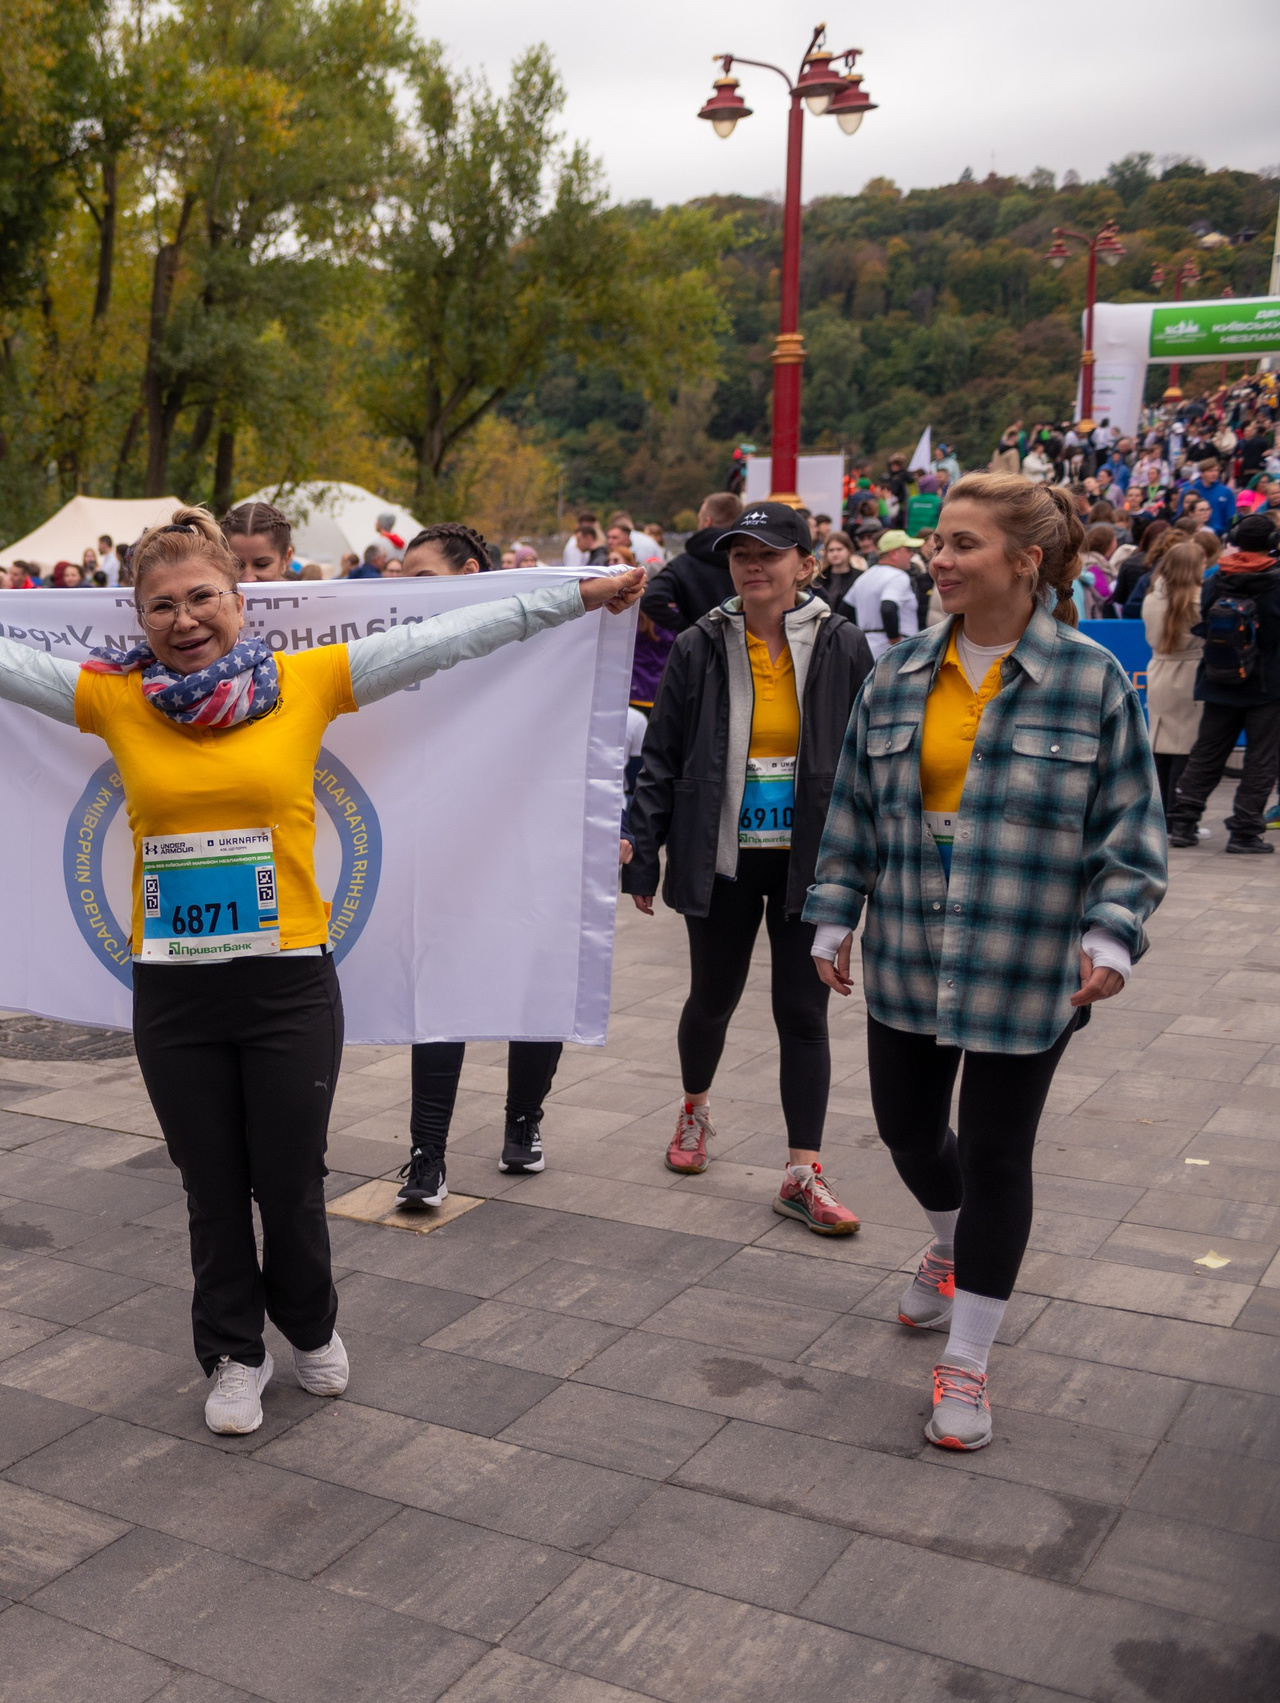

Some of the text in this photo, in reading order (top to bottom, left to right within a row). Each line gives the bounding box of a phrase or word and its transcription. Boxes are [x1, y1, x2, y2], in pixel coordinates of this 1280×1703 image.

[740, 806, 794, 829] 6910
[219, 834, 269, 846] UKRNAFTA
[160, 846, 195, 854] ARMOUR
[219, 856, 257, 864] НЕЗЛАМНОСТІ
[172, 901, 239, 935] 6871
[181, 942, 252, 956] ПриватБанк
